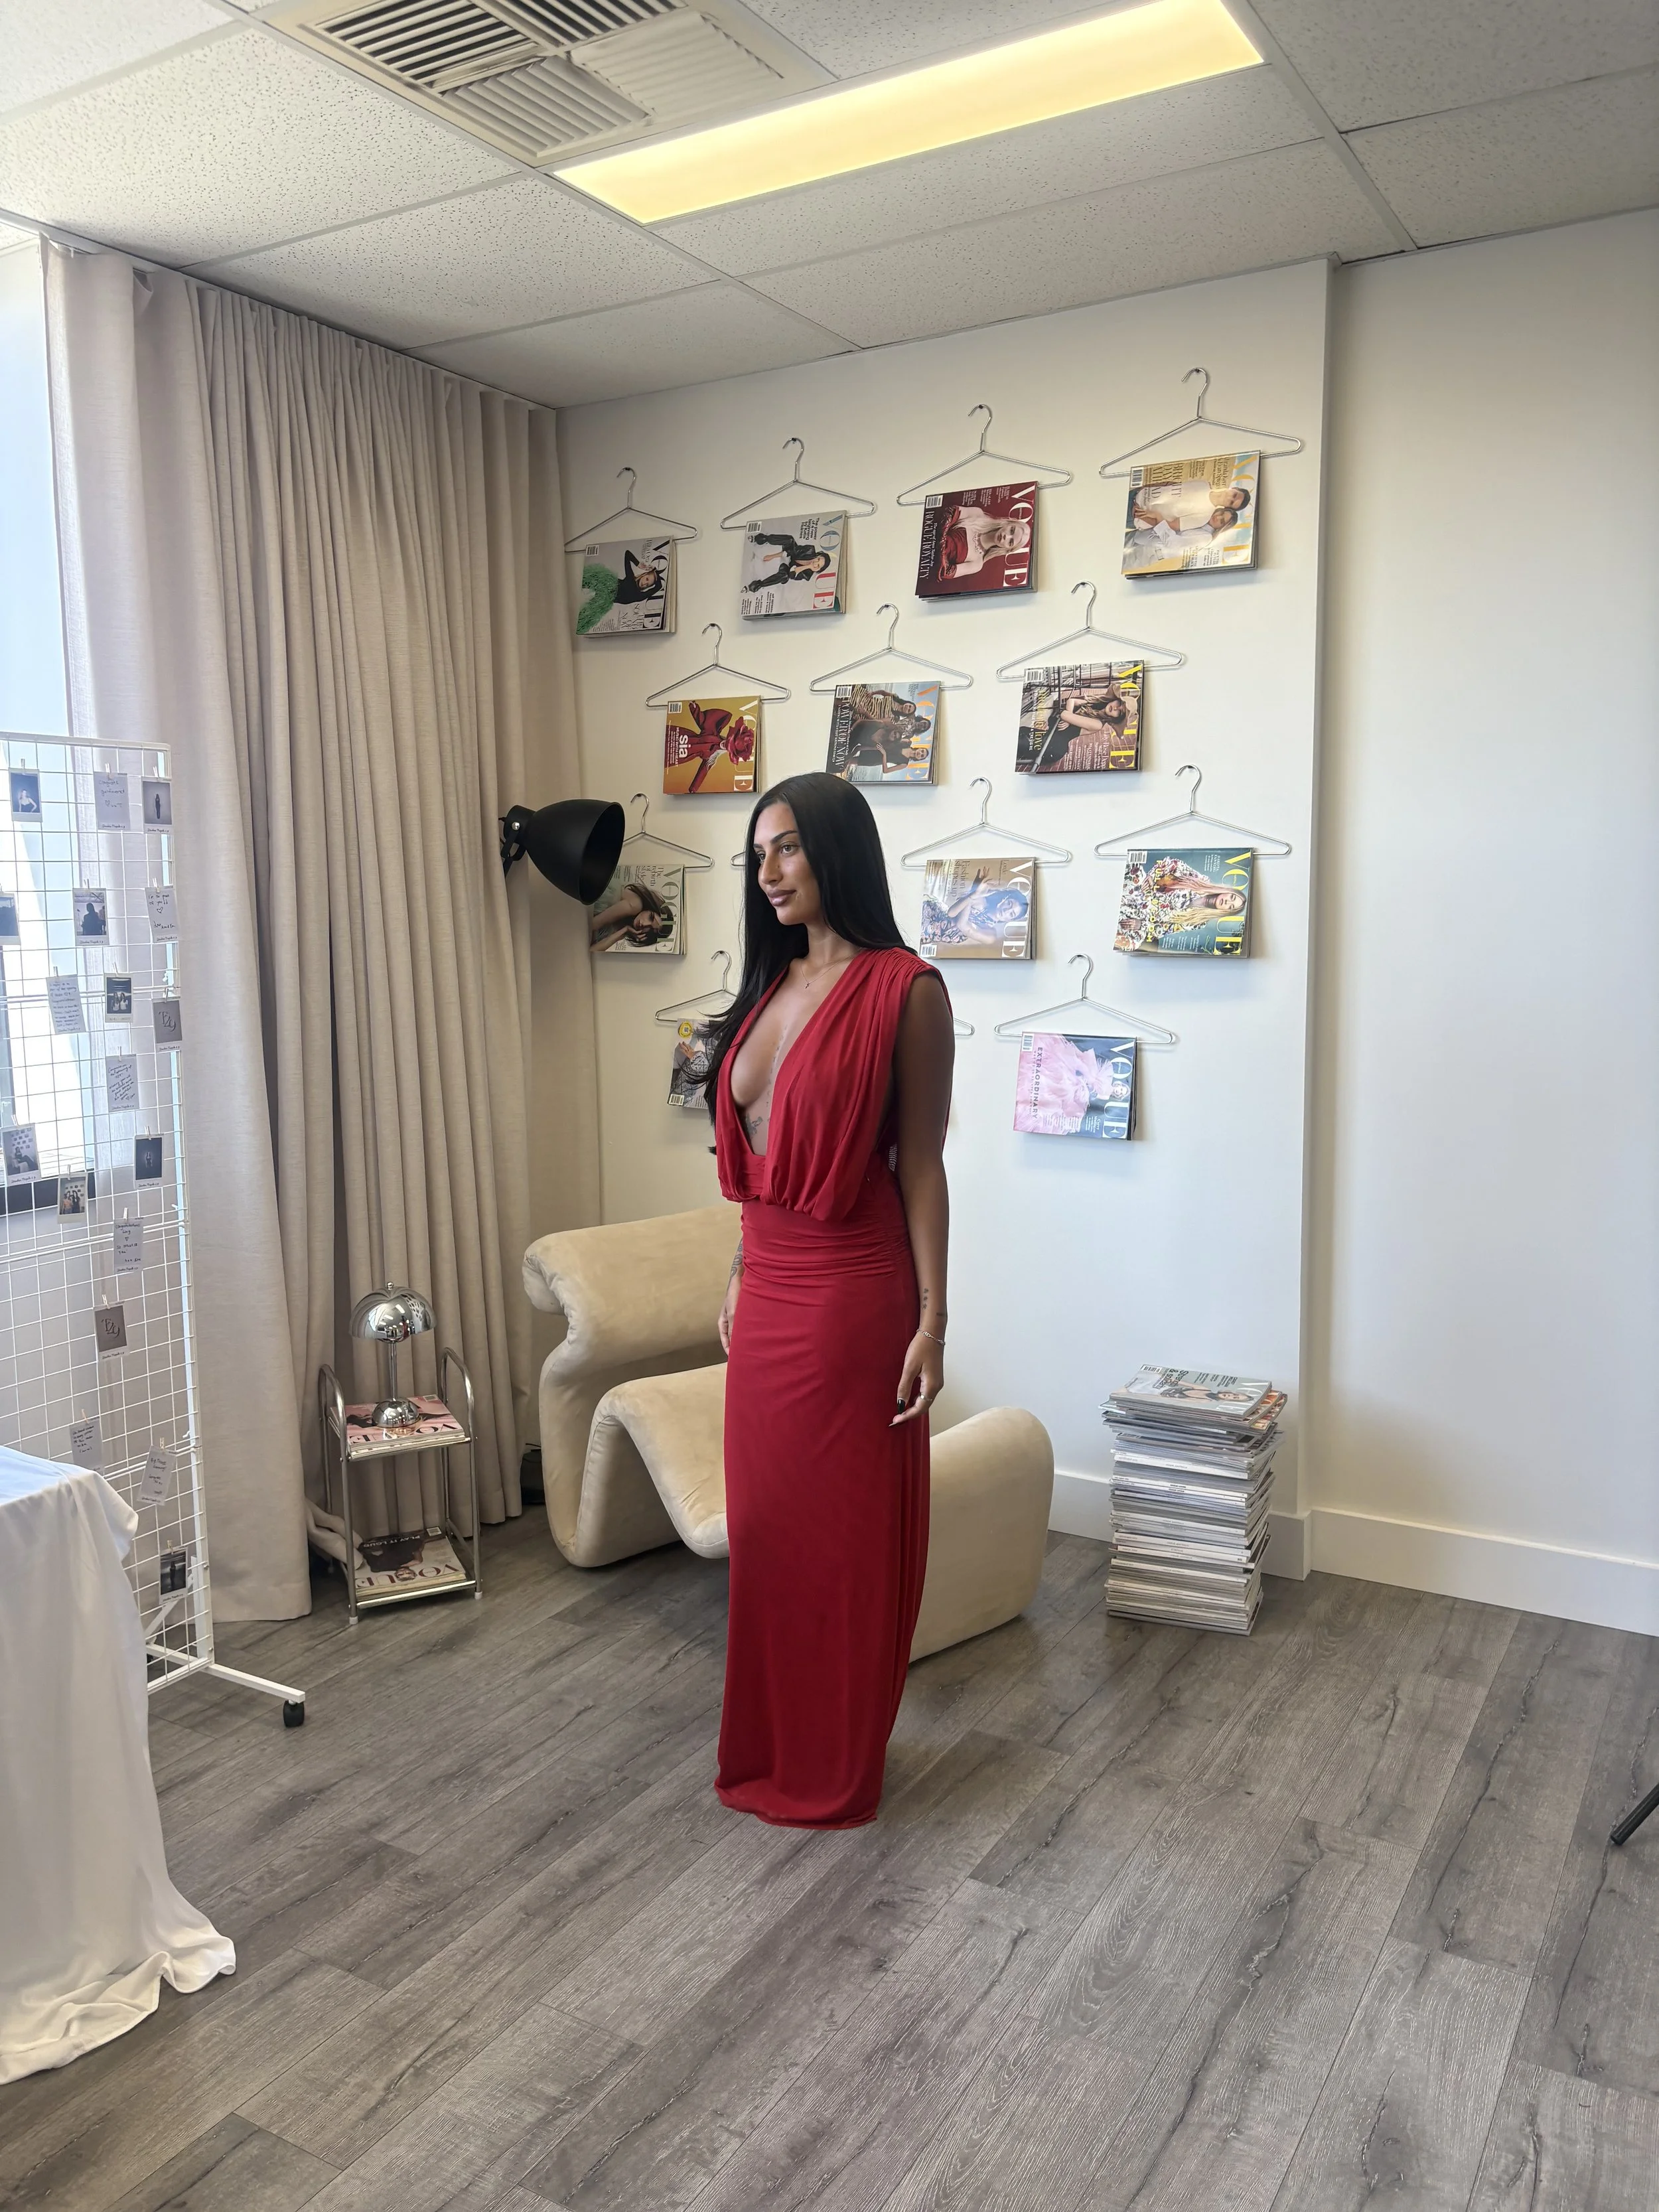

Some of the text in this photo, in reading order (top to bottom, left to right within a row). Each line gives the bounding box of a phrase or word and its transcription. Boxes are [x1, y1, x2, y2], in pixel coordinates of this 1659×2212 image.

[920, 511, 934, 579] ROGUE ROYALTY
[1003, 483, 1036, 587] VOUE
[1222, 456, 1257, 565] VOUE
[642, 540, 670, 629] VOUE
[813, 514, 843, 609] VOUE
[679, 735, 691, 758] sia
[733, 700, 758, 791] VOUE
[840, 699, 850, 732] POWER
[905, 685, 938, 780] VOUE
[1034, 731, 1048, 750] love
[1109, 665, 1142, 769] VOUE
[835, 746, 845, 766] NOW
[655, 867, 682, 952] VOGUE
[953, 860, 962, 885] shapes
[960, 861, 970, 889] Fashion
[1001, 859, 1033, 958] VOUE
[1153, 860, 1162, 891] FULL
[1213, 849, 1251, 955] VOUE
[1032, 1047, 1043, 1119] EXTRAORDINARY
[1102, 1040, 1135, 1138] VOUE
[355, 1564, 459, 1588] VOUE
[399, 1534, 421, 1543] PLAY
